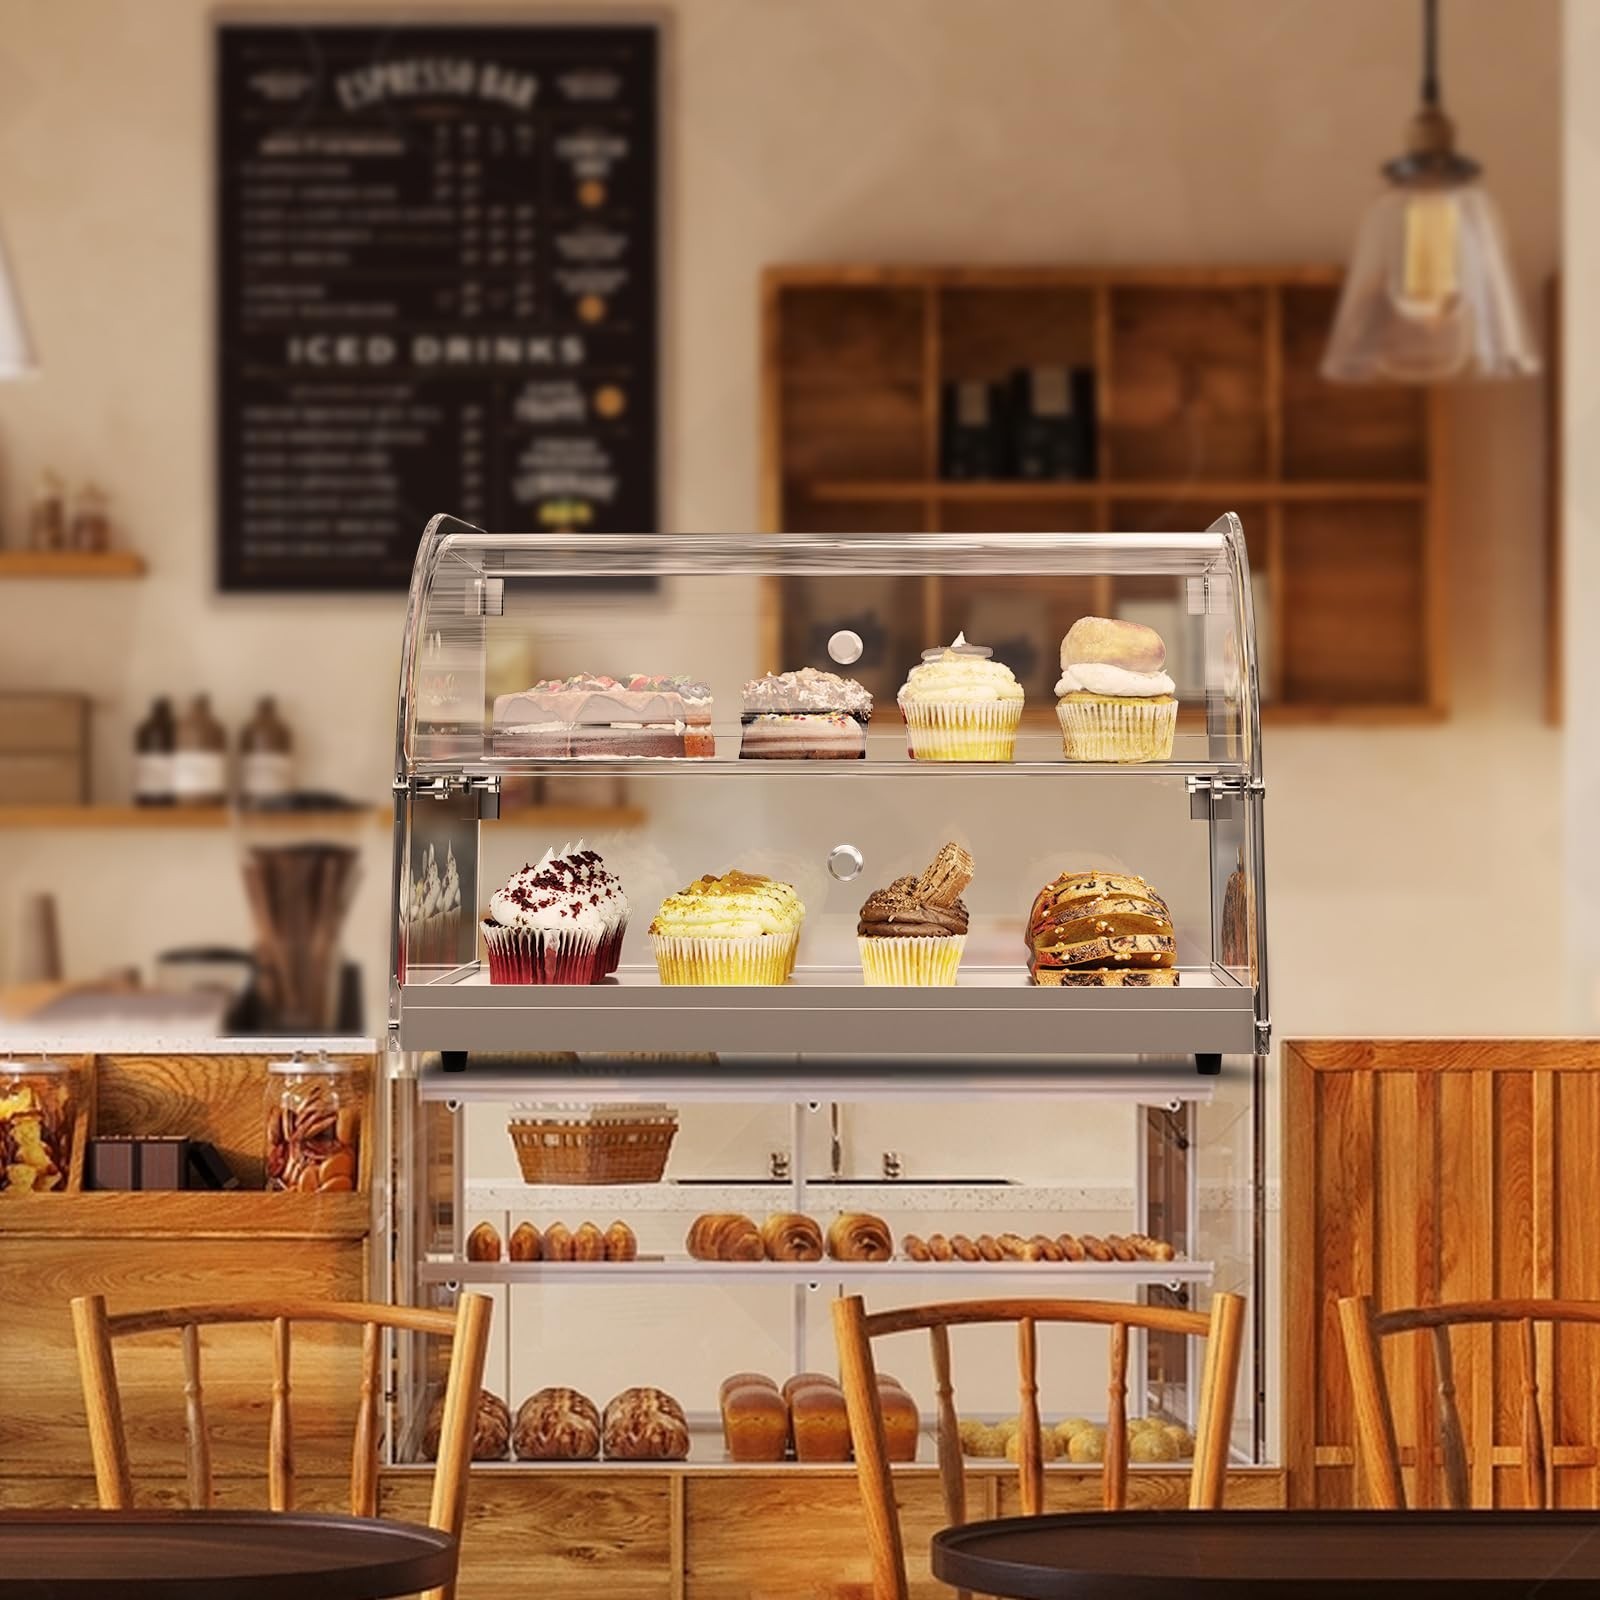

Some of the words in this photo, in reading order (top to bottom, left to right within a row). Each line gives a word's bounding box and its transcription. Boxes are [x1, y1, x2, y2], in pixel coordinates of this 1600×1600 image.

[336, 60, 475, 109] ESPRESSO
[481, 64, 538, 109] BAR
[289, 336, 396, 365] ICED
[412, 336, 585, 365] DRINKS
